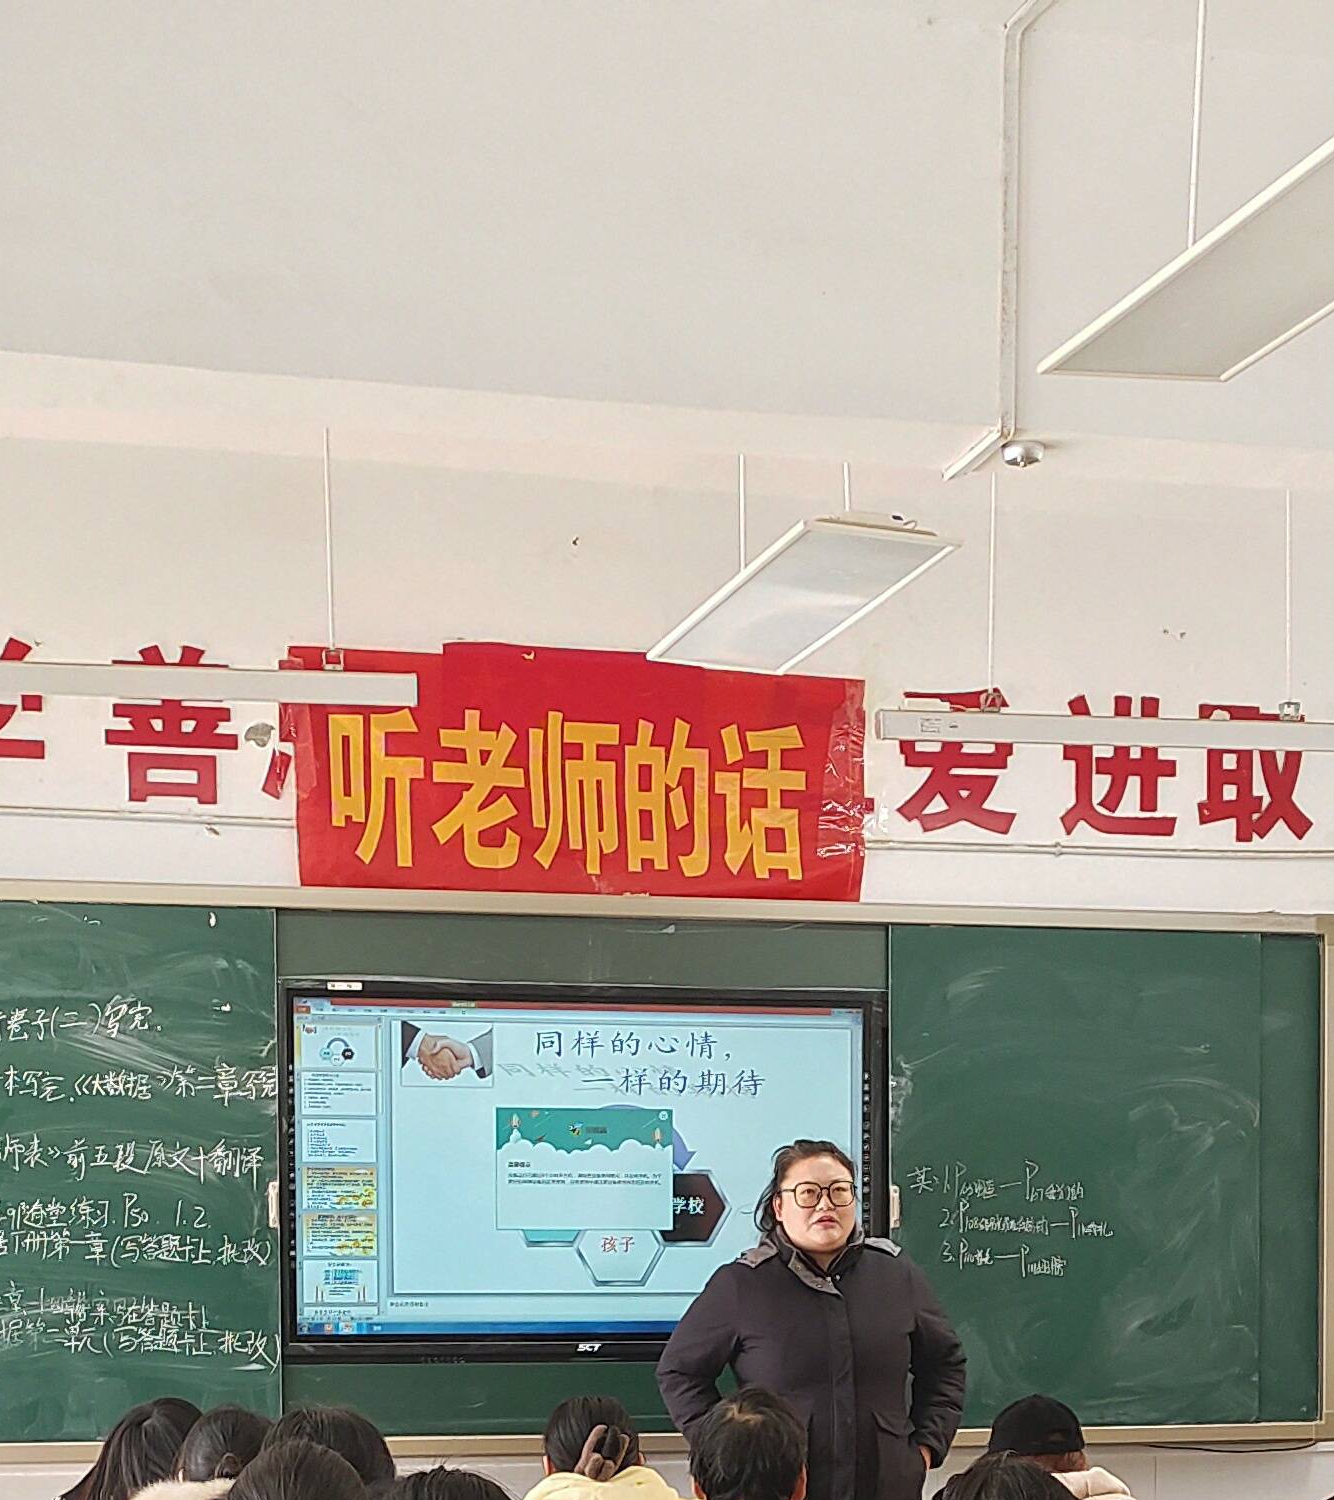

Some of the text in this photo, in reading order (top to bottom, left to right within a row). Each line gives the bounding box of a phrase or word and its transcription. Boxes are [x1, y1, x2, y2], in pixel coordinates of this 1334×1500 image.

[328, 707, 807, 881] 听老师的话
[582, 1069, 766, 1096] 一样的期待
[673, 1197, 705, 1215] 学校
[601, 1236, 635, 1253] 孩子
